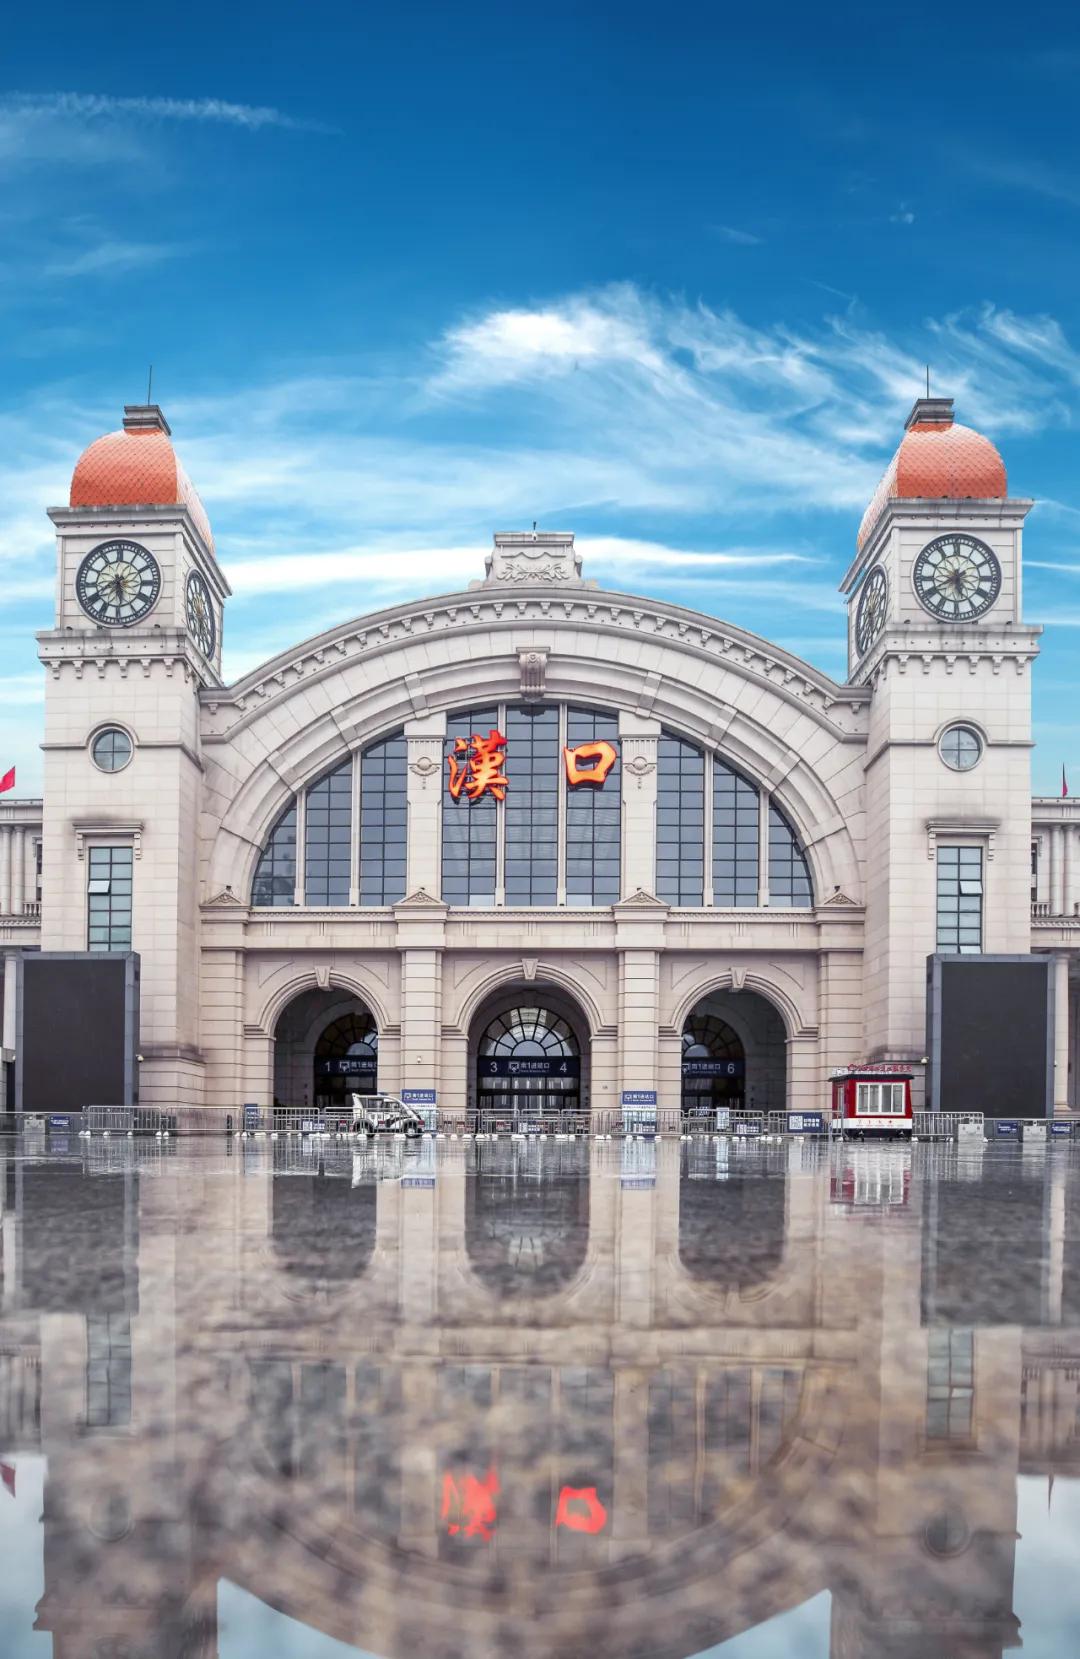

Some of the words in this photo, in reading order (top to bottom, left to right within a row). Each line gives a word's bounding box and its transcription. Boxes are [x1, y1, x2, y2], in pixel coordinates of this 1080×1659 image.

[448, 729, 617, 801] 漢口
[325, 1061, 330, 1072] 1
[490, 1061, 498, 1073] 3
[559, 1061, 568, 1073] 4
[727, 1063, 735, 1074] 6
